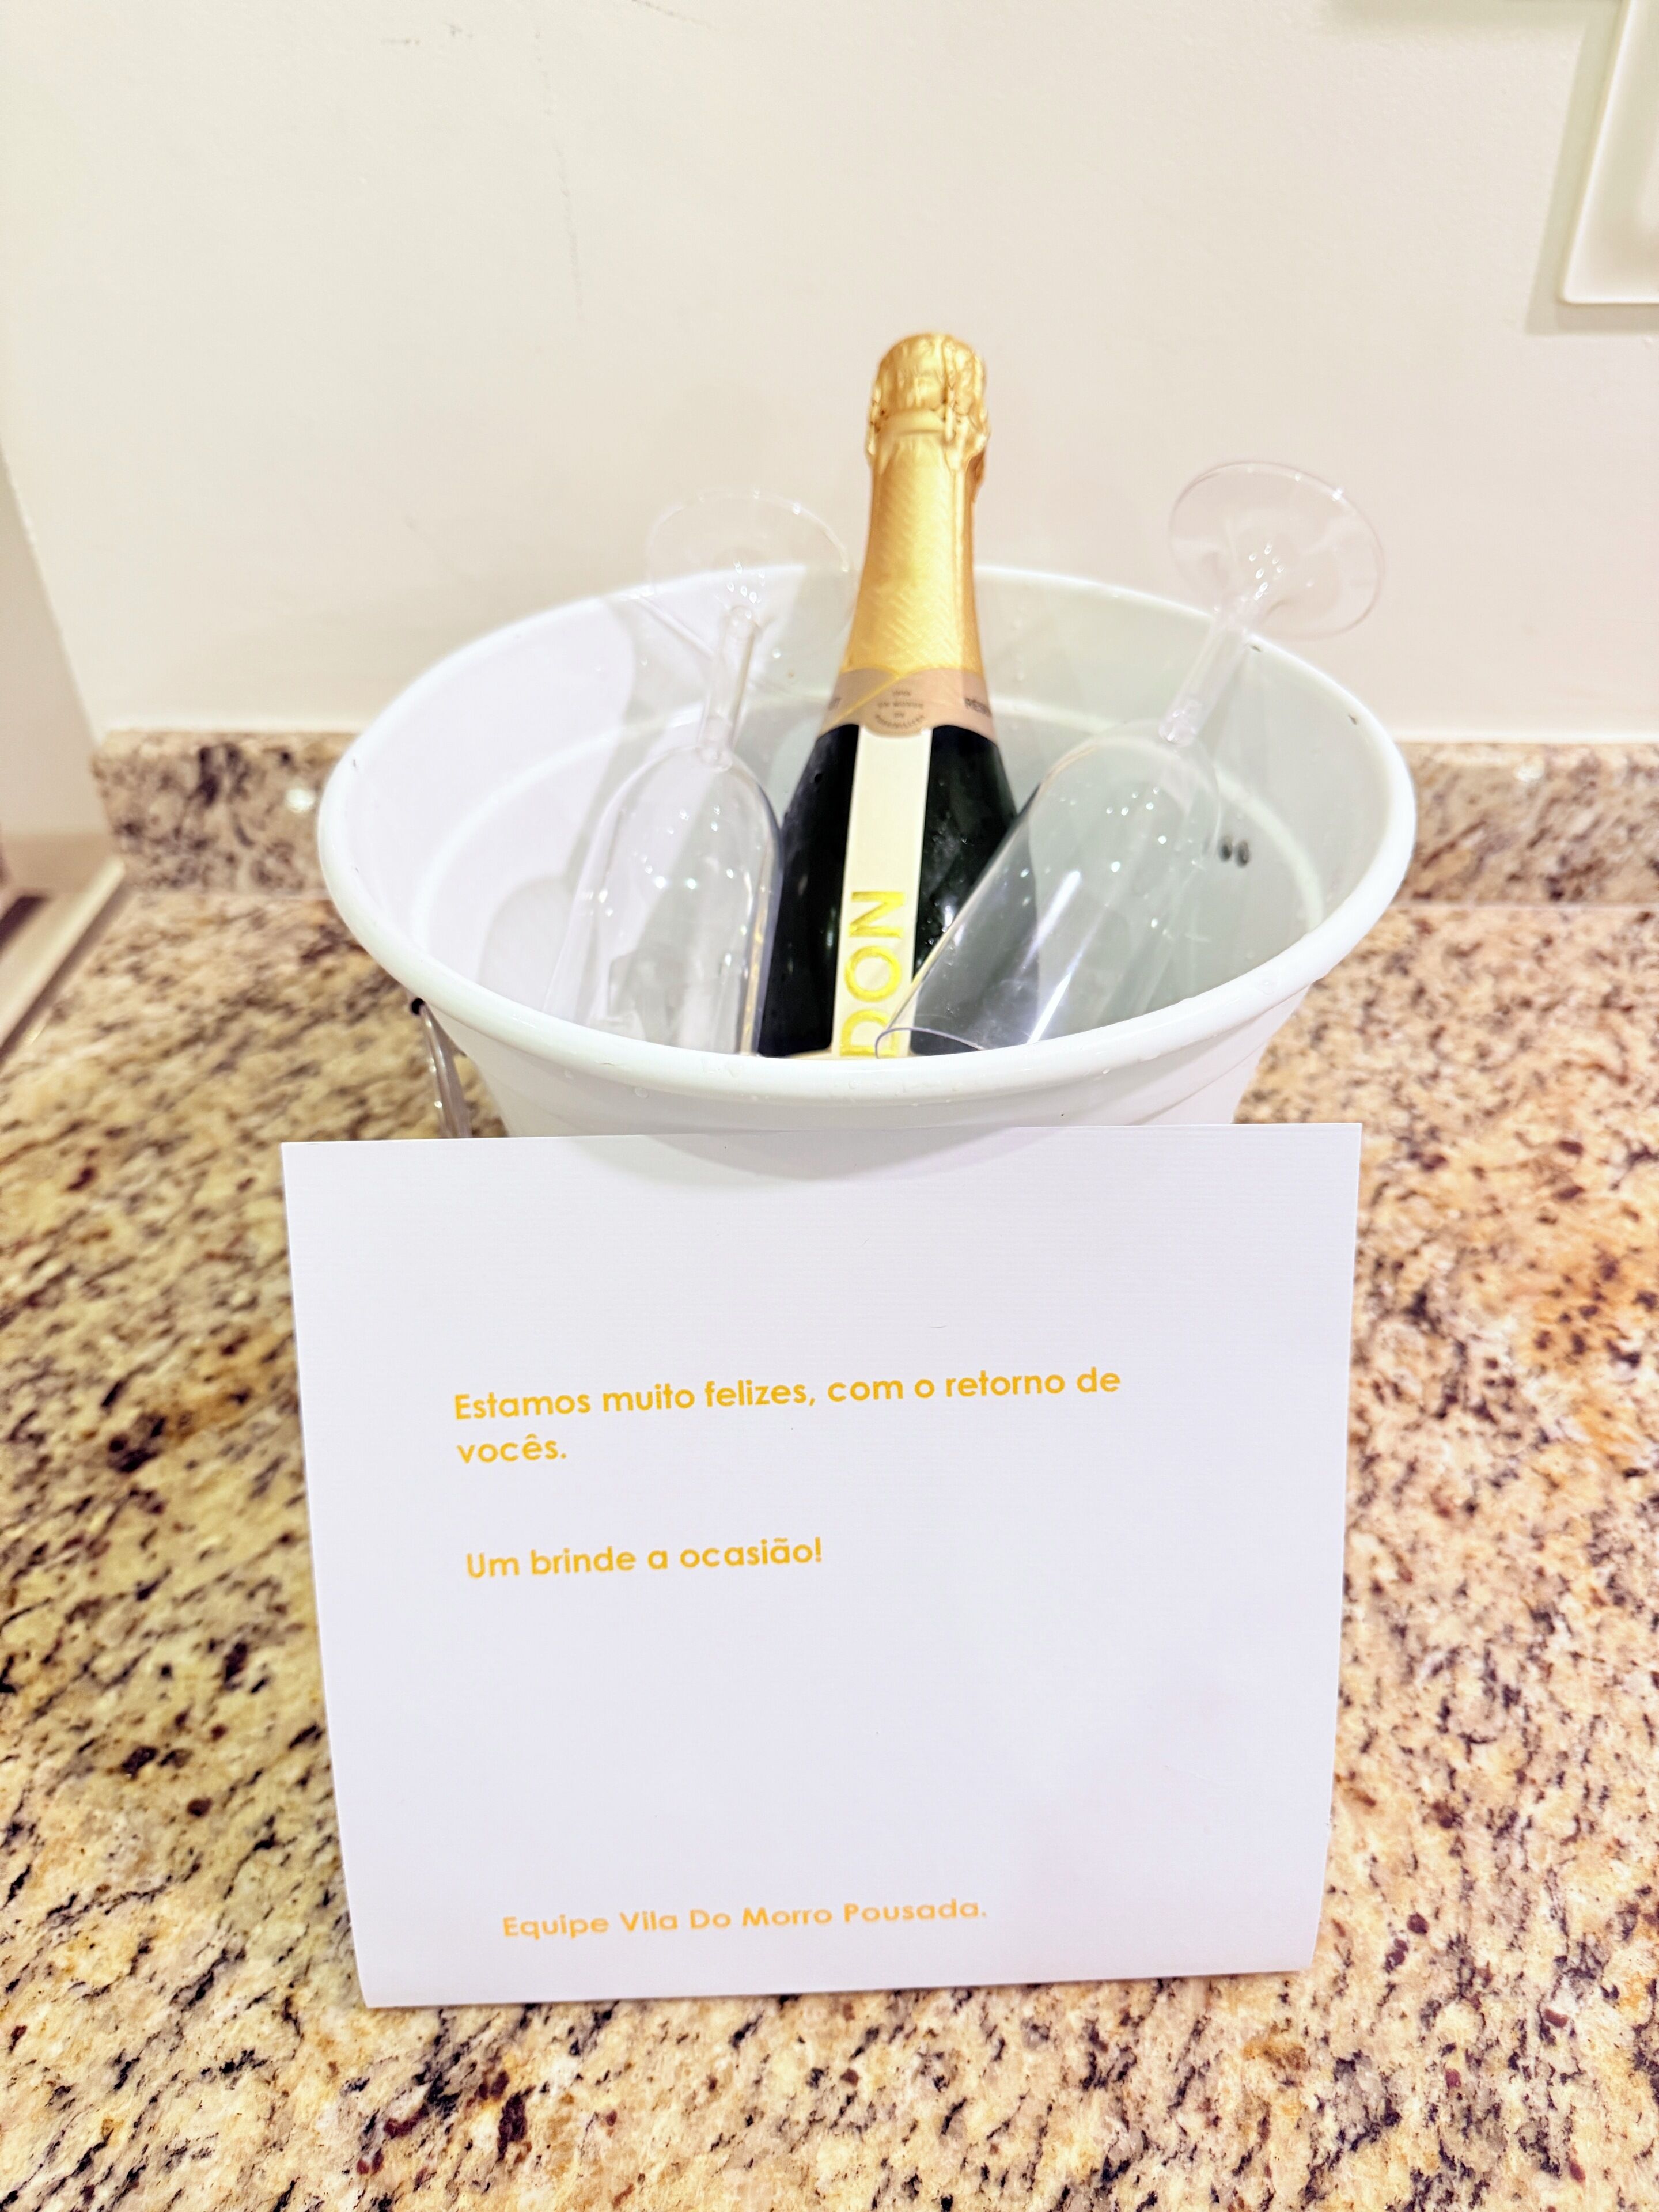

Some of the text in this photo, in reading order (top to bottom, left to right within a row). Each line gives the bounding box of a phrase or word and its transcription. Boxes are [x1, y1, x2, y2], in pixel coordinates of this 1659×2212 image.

[454, 1367, 1120, 1419] Estamos muito felizes, com o retorno de
[457, 1434, 566, 1463] vocês.
[467, 1537, 821, 1578] Um brinde a ocasião!
[503, 1899, 986, 1940] Equipe Vila Do Morro Pousada.
